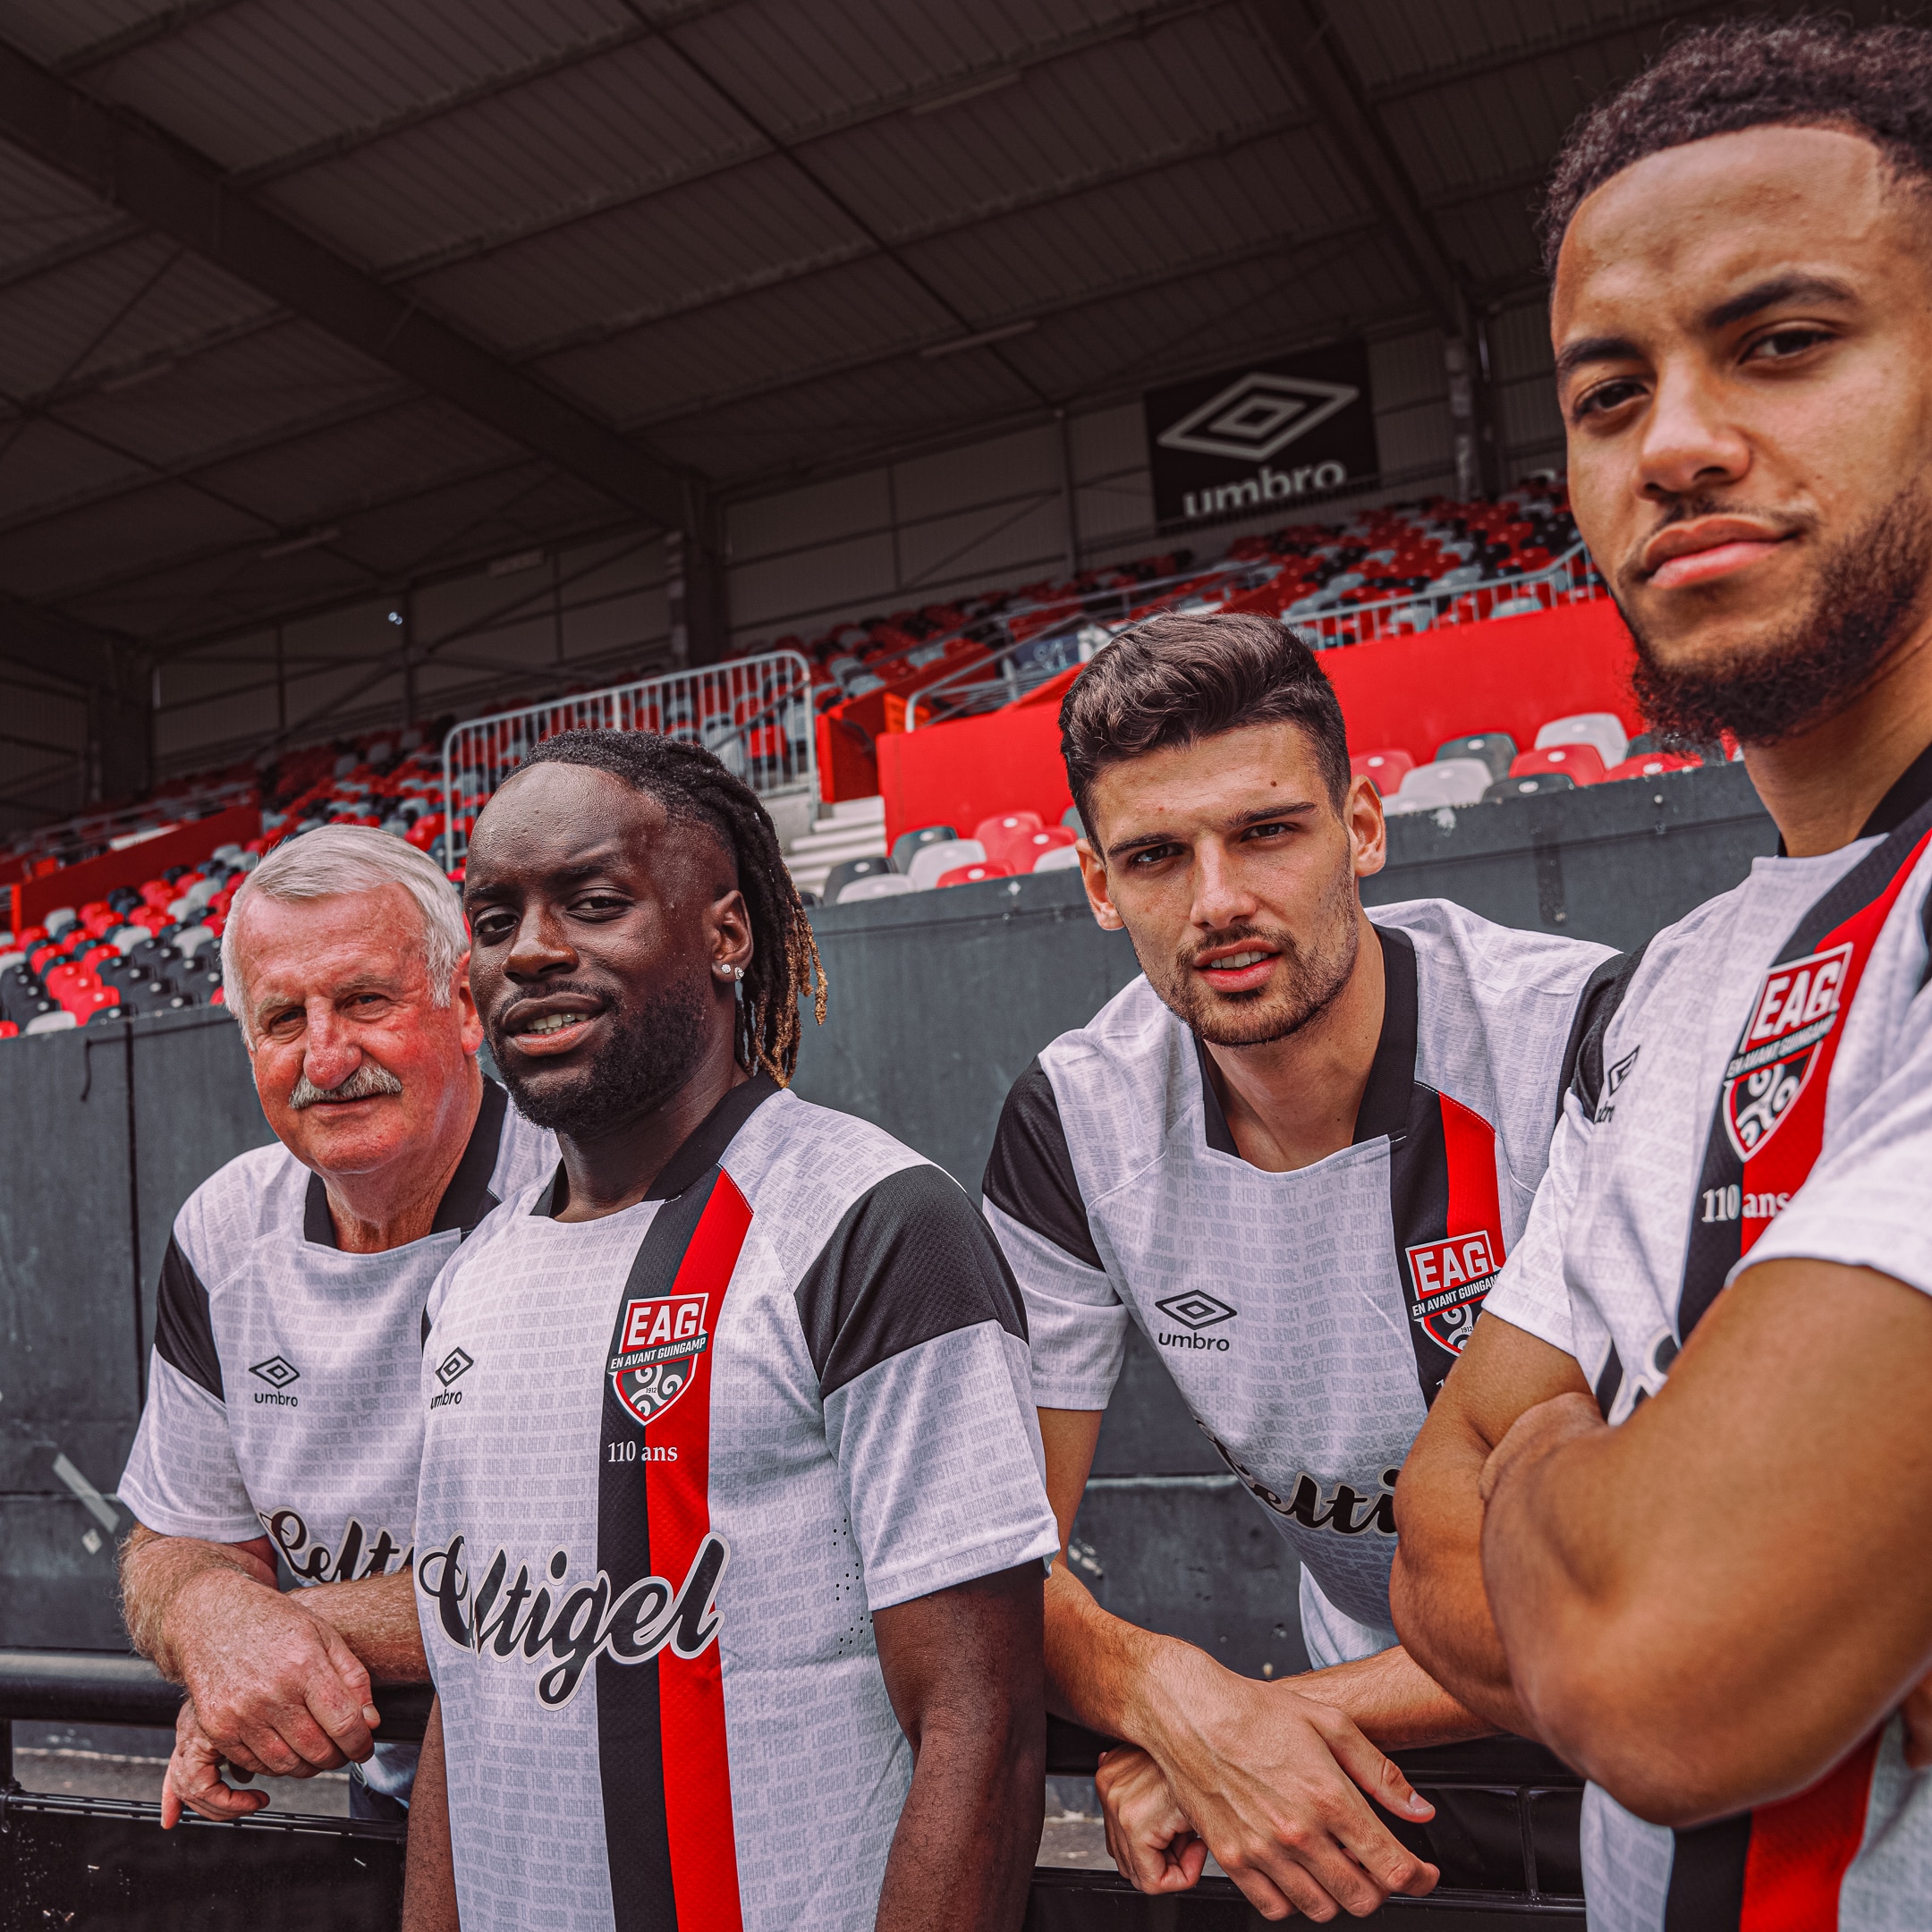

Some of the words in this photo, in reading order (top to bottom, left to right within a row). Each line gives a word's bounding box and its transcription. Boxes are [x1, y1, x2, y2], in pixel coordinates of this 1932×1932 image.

[1183, 461, 1346, 518] umbro
[1750, 961, 1842, 1040] EAG
[1701, 1183, 1741, 1223] 110
[1742, 1191, 1790, 1218] ans
[1414, 1241, 1489, 1292] EAG
[627, 1302, 699, 1346] EAG
[1412, 1302, 1427, 1317] EN
[1428, 1291, 1457, 1311] AVANT
[610, 1357, 623, 1369] EN
[624, 1350, 657, 1367] AVANT
[657, 1337, 707, 1360] GUINGAMP
[1158, 1332, 1230, 1352] umbro
[254, 1391, 298, 1407] umbro
[430, 1388, 462, 1410] umbro
[607, 1440, 636, 1462] 110
[641, 1445, 678, 1462] ans
[256, 1506, 417, 1584] Celt
[418, 1530, 731, 1711] Cltigel
